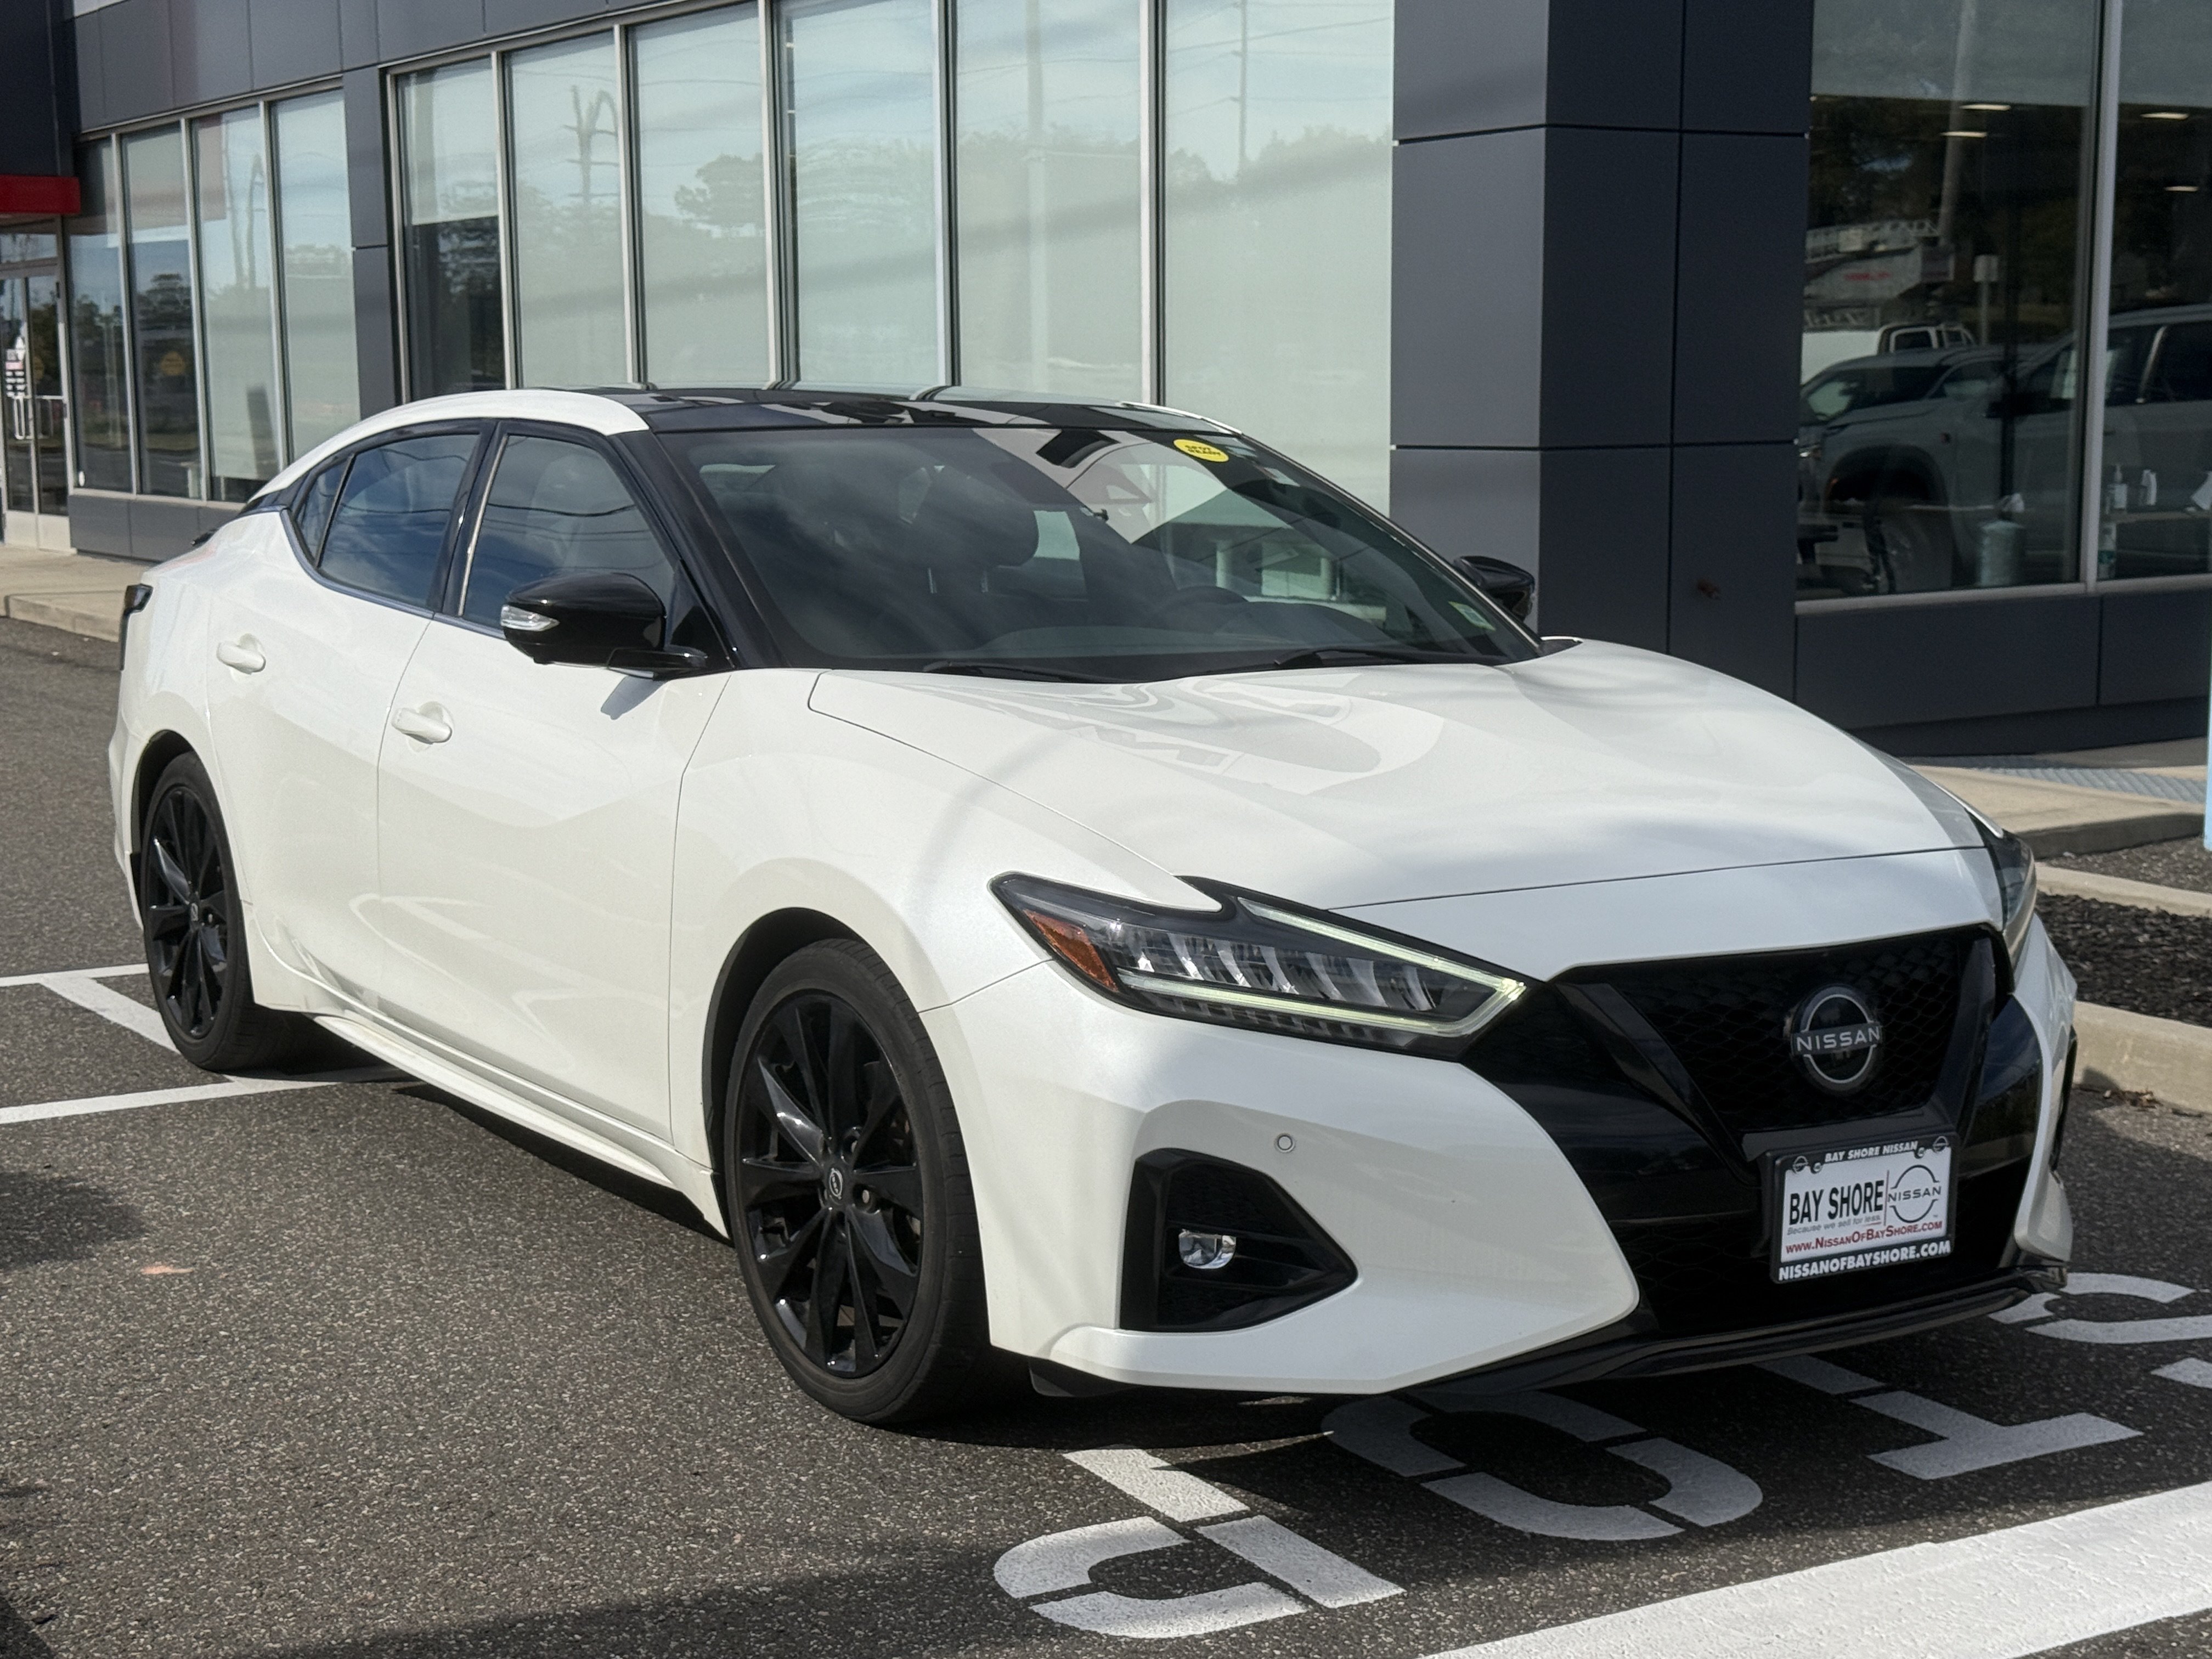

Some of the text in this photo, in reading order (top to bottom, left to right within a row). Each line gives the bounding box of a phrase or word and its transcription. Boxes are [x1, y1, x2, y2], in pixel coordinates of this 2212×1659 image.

[1796, 1026, 1880, 1051] NISSAN
[1825, 1141, 1918, 1162] BAY SHORE NISSAN
[1789, 1180, 1884, 1225] BAY SHORE
[1888, 1186, 1941, 1202] NISSAN
[1779, 1240, 1951, 1280] NISSANOFBAYSHORE.COM
